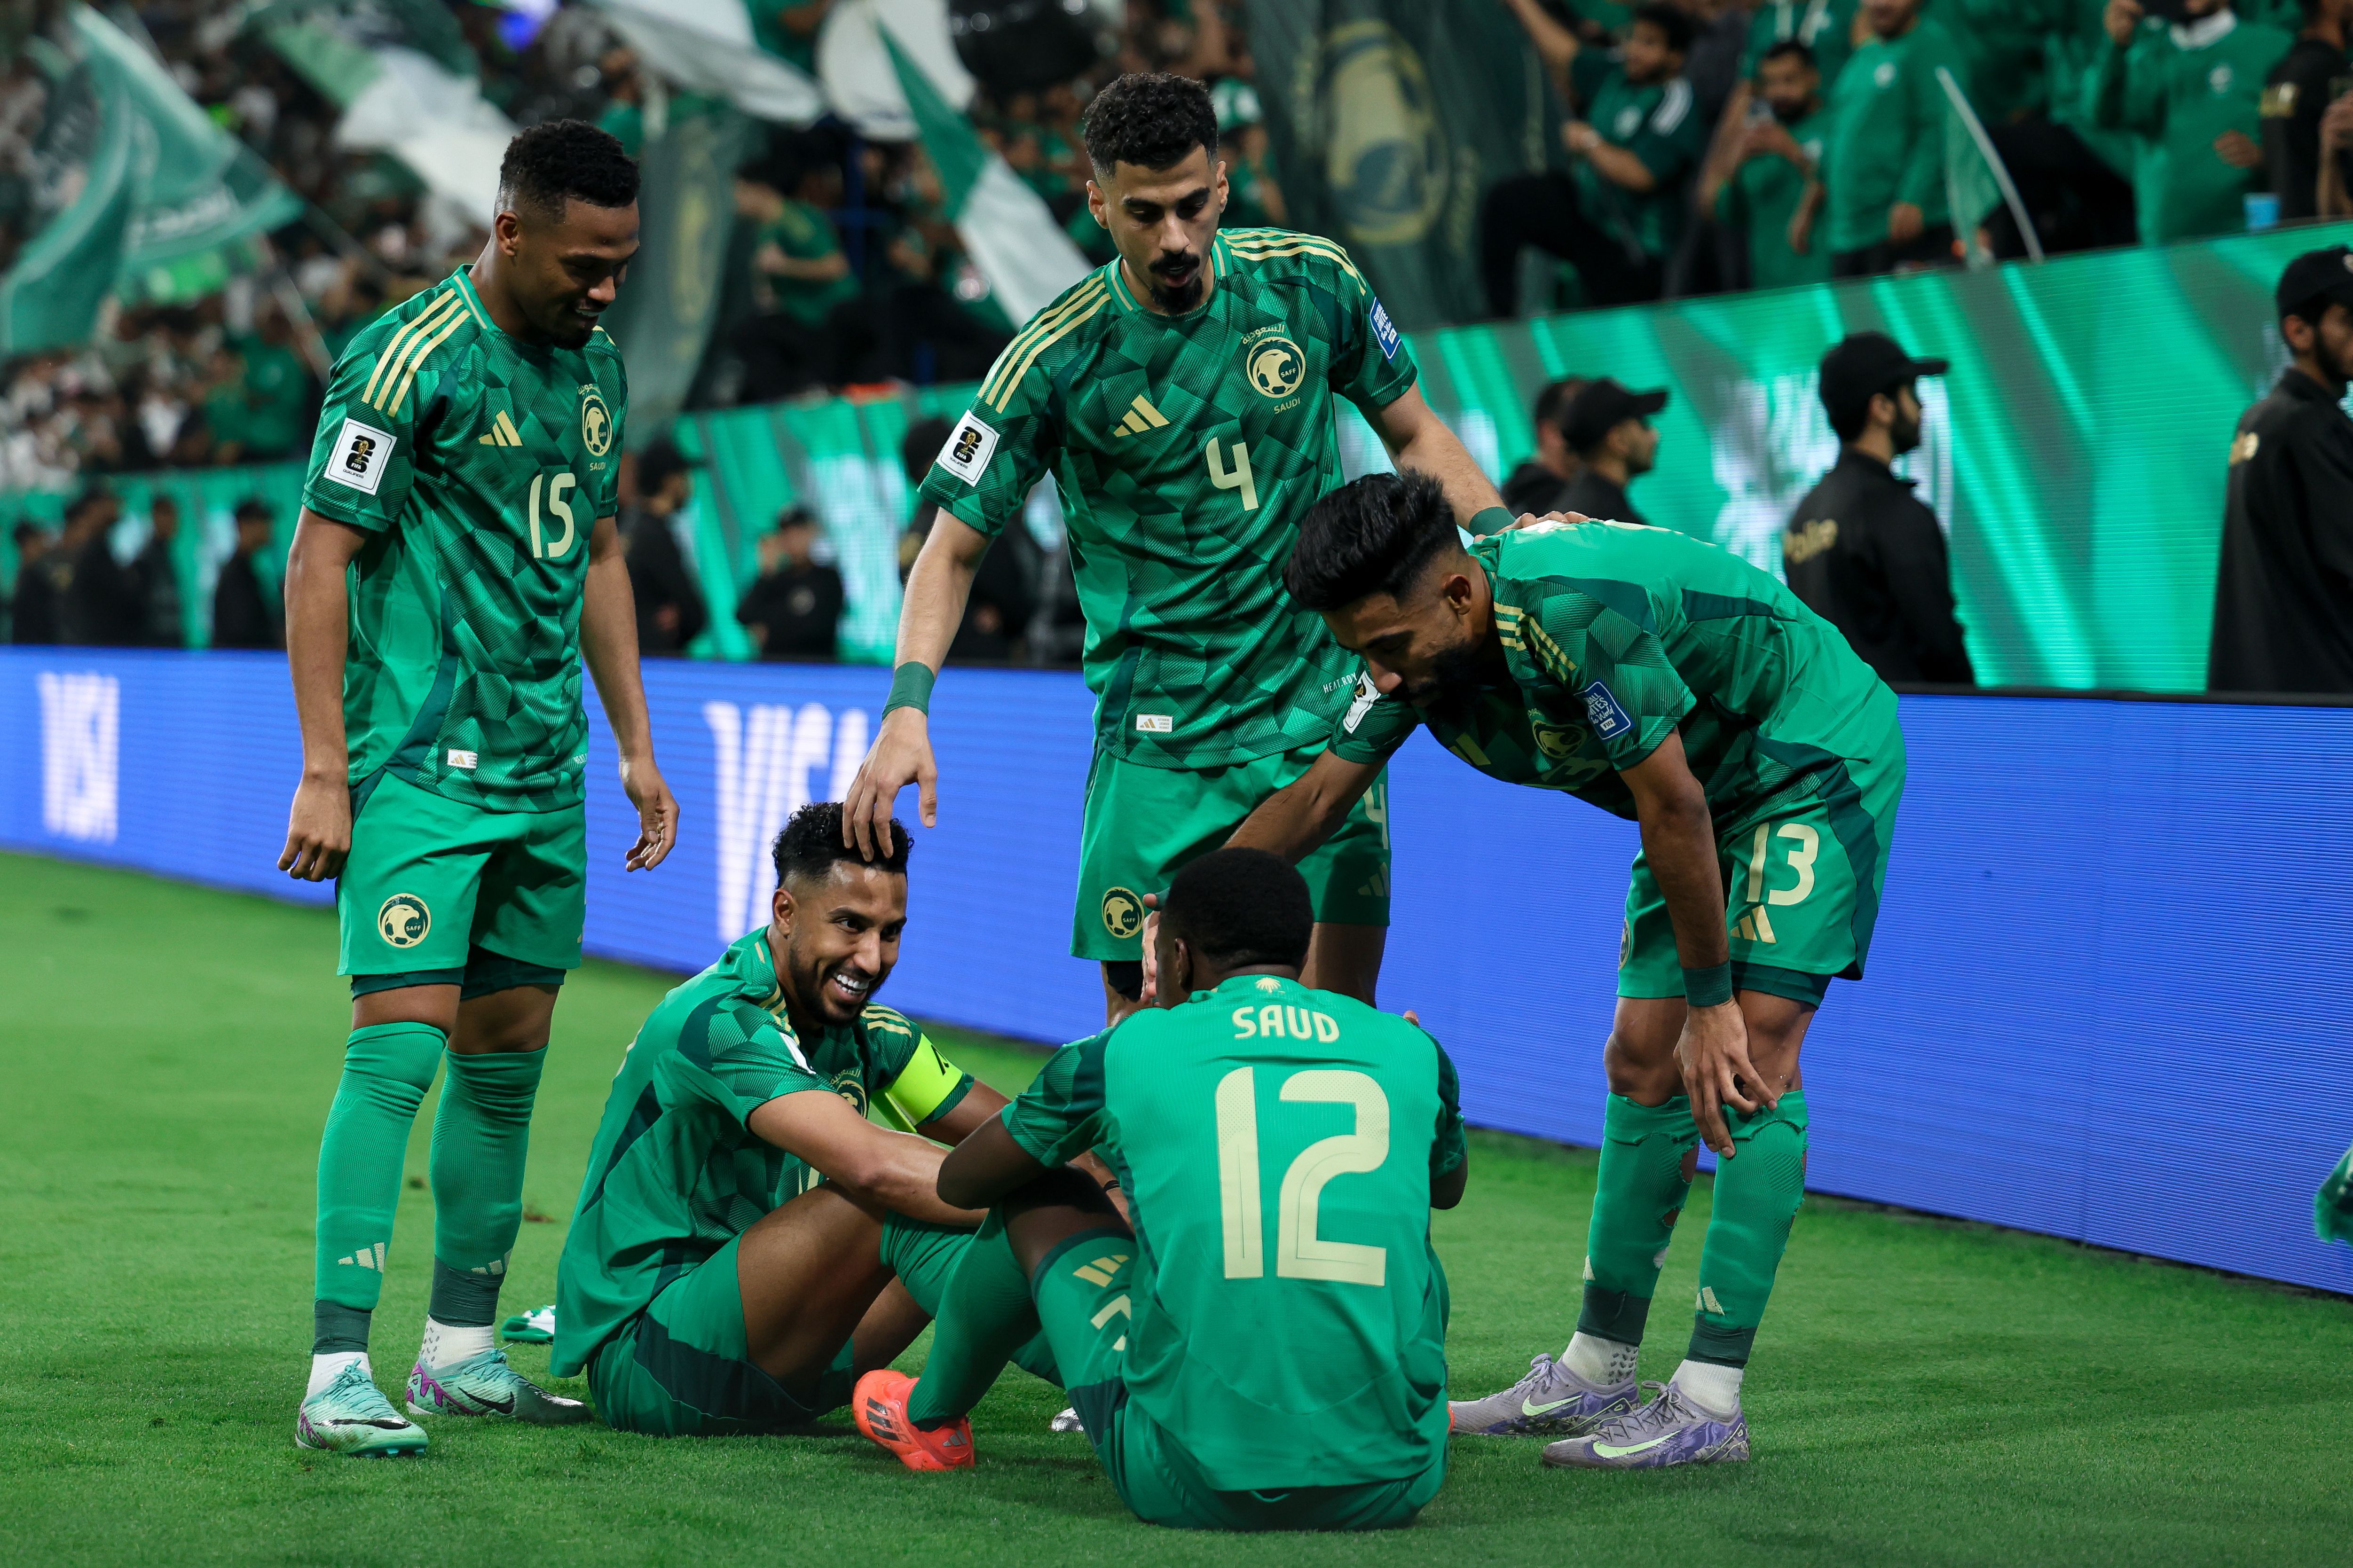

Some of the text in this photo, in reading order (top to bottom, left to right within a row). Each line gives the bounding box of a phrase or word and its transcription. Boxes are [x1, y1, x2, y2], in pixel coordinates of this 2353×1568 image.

[1241, 323, 1285, 345] السعودية
[1280, 368, 1297, 378] SAFF
[1274, 397, 1301, 414] SAUDI
[589, 462, 606, 471] SAUDI
[956, 451, 967, 460] FIFA
[1206, 437, 1259, 511] 4
[529, 472, 576, 558] 15
[1323, 672, 1358, 694] HEAT.RDY
[1596, 705, 1615, 721] World
[1604, 720, 1614, 729] FIFA
[1362, 783, 1389, 850] 4
[1746, 822, 1820, 906] 13
[1231, 1004, 1340, 1043] SAUD
[1214, 1066, 1390, 1287] 12
